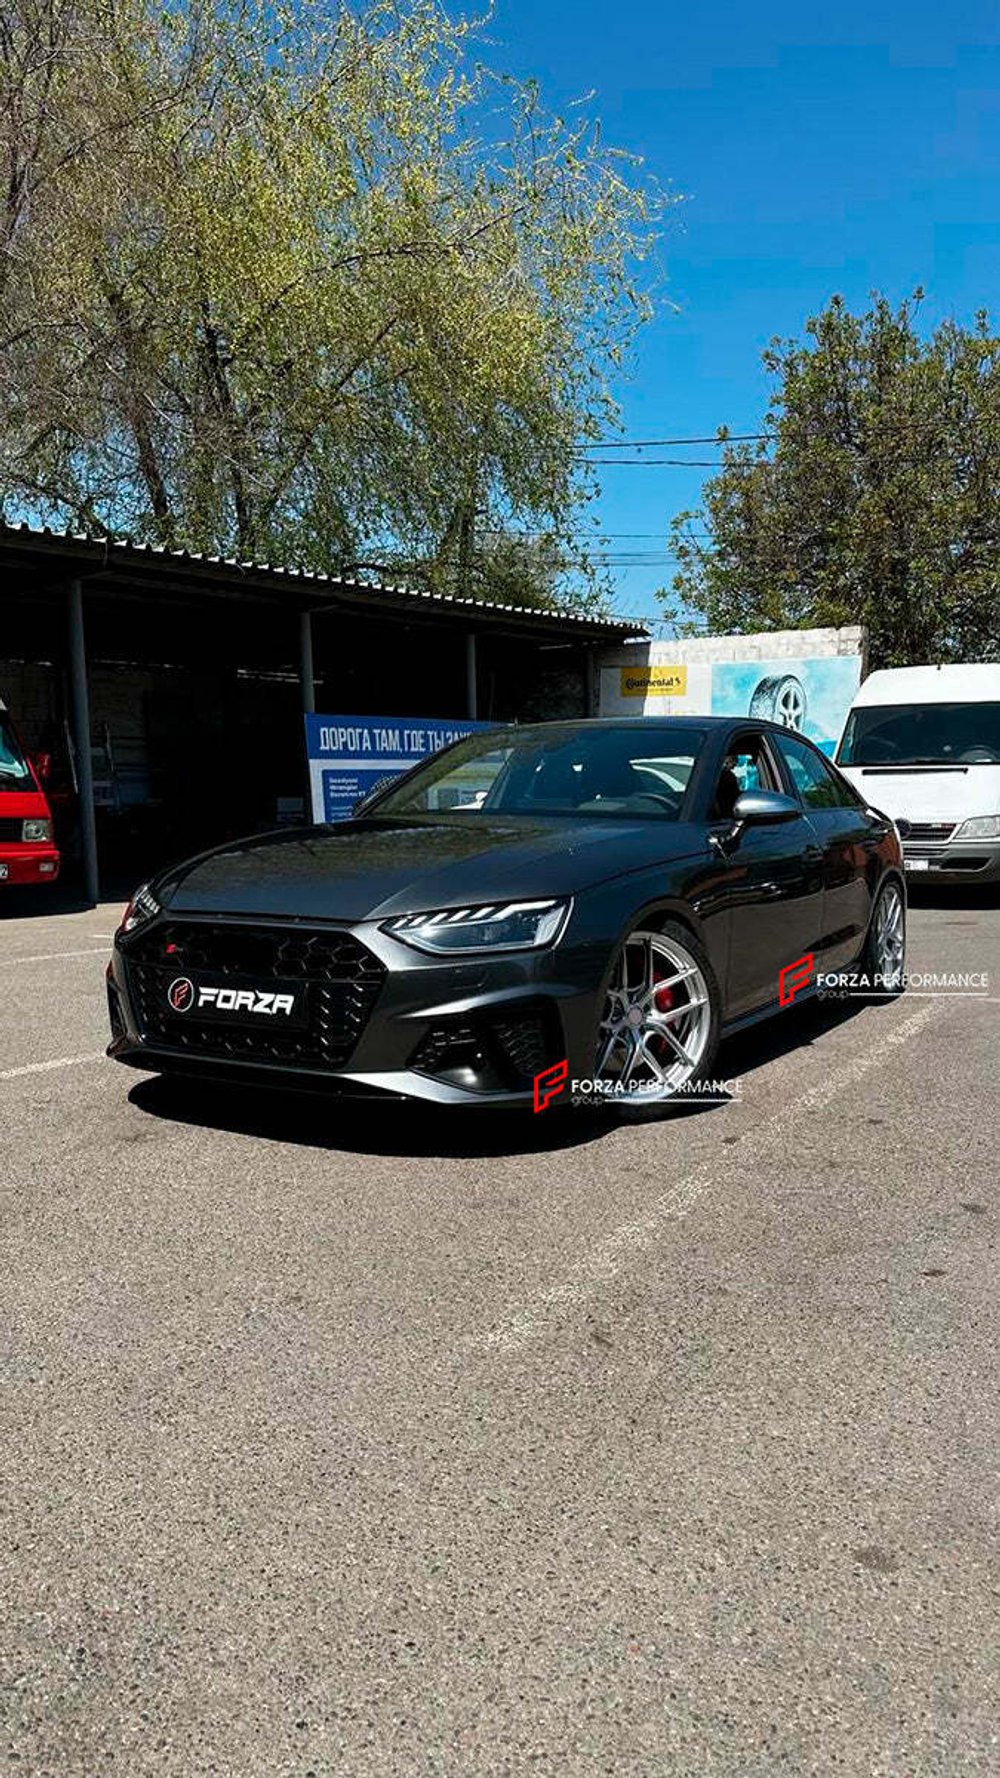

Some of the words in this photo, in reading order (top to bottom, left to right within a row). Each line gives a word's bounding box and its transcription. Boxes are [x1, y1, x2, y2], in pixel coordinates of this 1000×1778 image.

[319, 727, 371, 751] ДОРОГА
[373, 729, 403, 753] ТАМ,
[404, 730, 426, 753] ГДЕ
[426, 730, 445, 753] ТЫ
[198, 986, 295, 1016] FORZA
